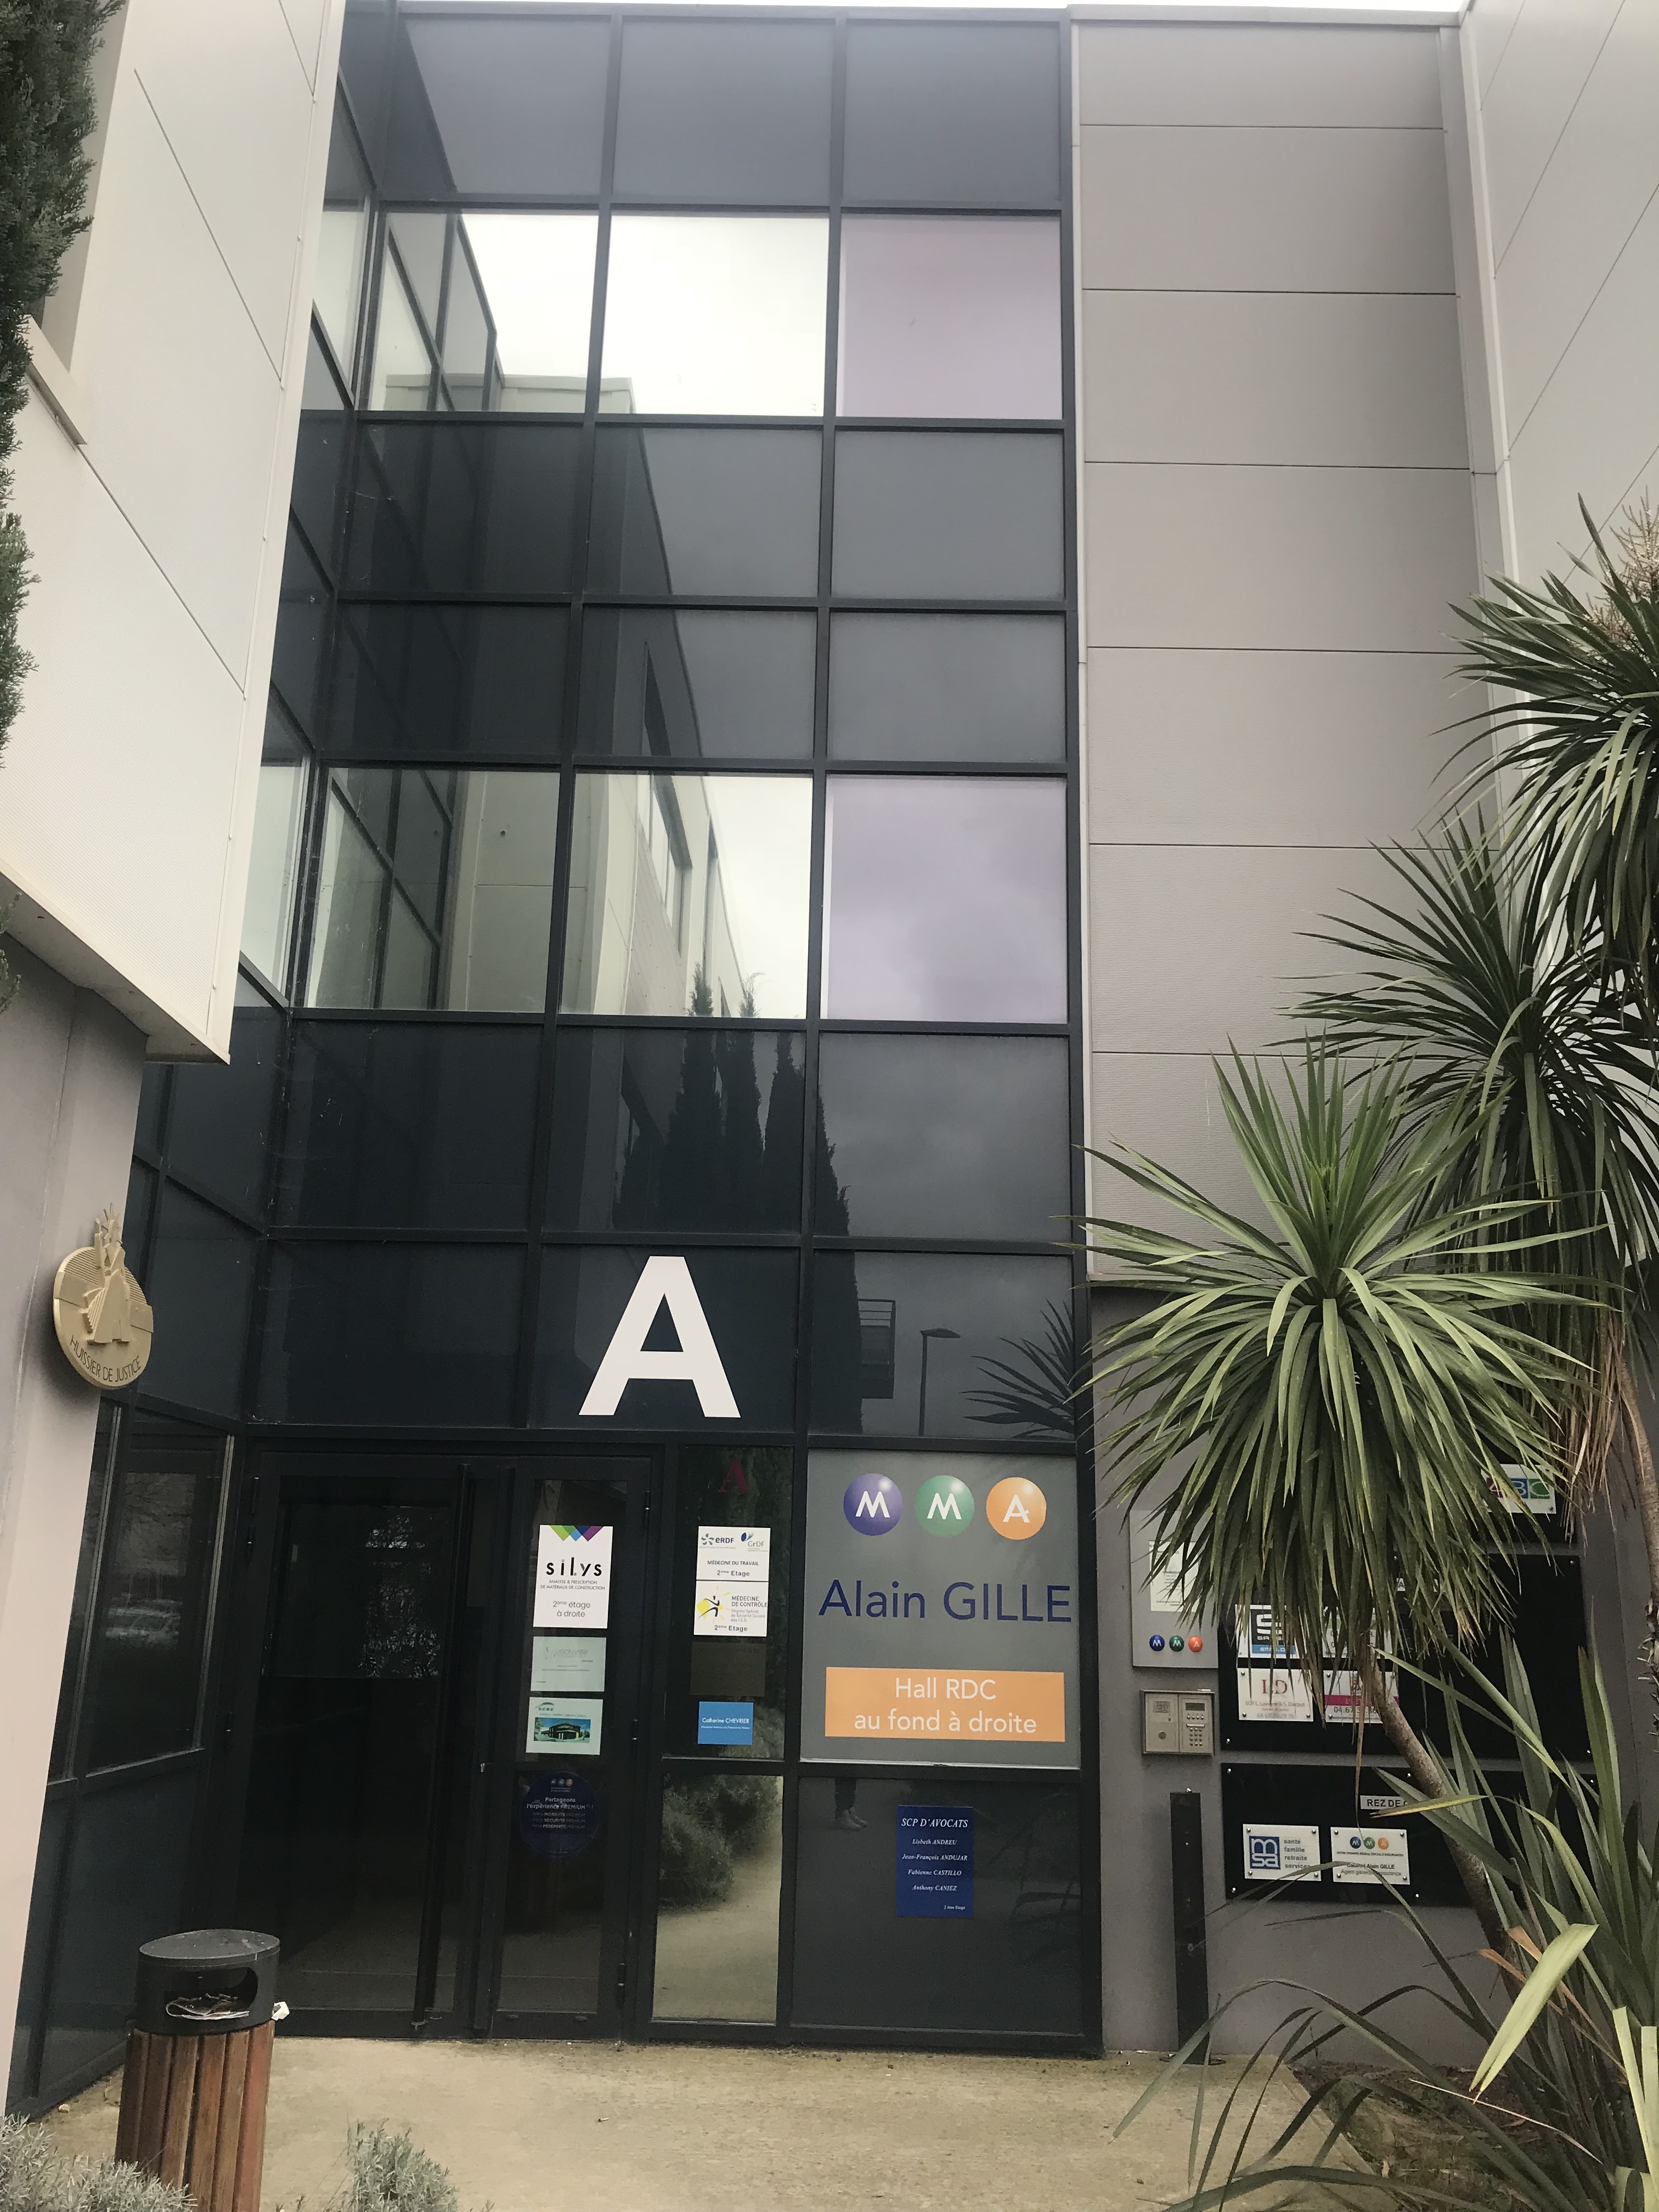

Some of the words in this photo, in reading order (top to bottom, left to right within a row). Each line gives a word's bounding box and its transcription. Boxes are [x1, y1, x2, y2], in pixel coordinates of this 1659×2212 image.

[579, 1256, 741, 1418] A
[70, 1335, 100, 1378] HUISSIER
[103, 1367, 113, 1382] DE
[115, 1356, 142, 1383] JUSTICE
[718, 1455, 750, 1493] A
[568, 1601, 590, 1610] étage
[819, 1579, 925, 1618] Alain
[943, 1582, 1071, 1622] GILLE
[895, 1677, 937, 1699] Hall
[946, 1679, 996, 1700] RDC
[854, 1715, 880, 1730] au
[888, 1708, 939, 1731] fond
[949, 1712, 961, 1732] à
[969, 1713, 1037, 1734] droite
[901, 1818, 918, 1827] SCP
[920, 1819, 968, 1828] D'AVOCATS
